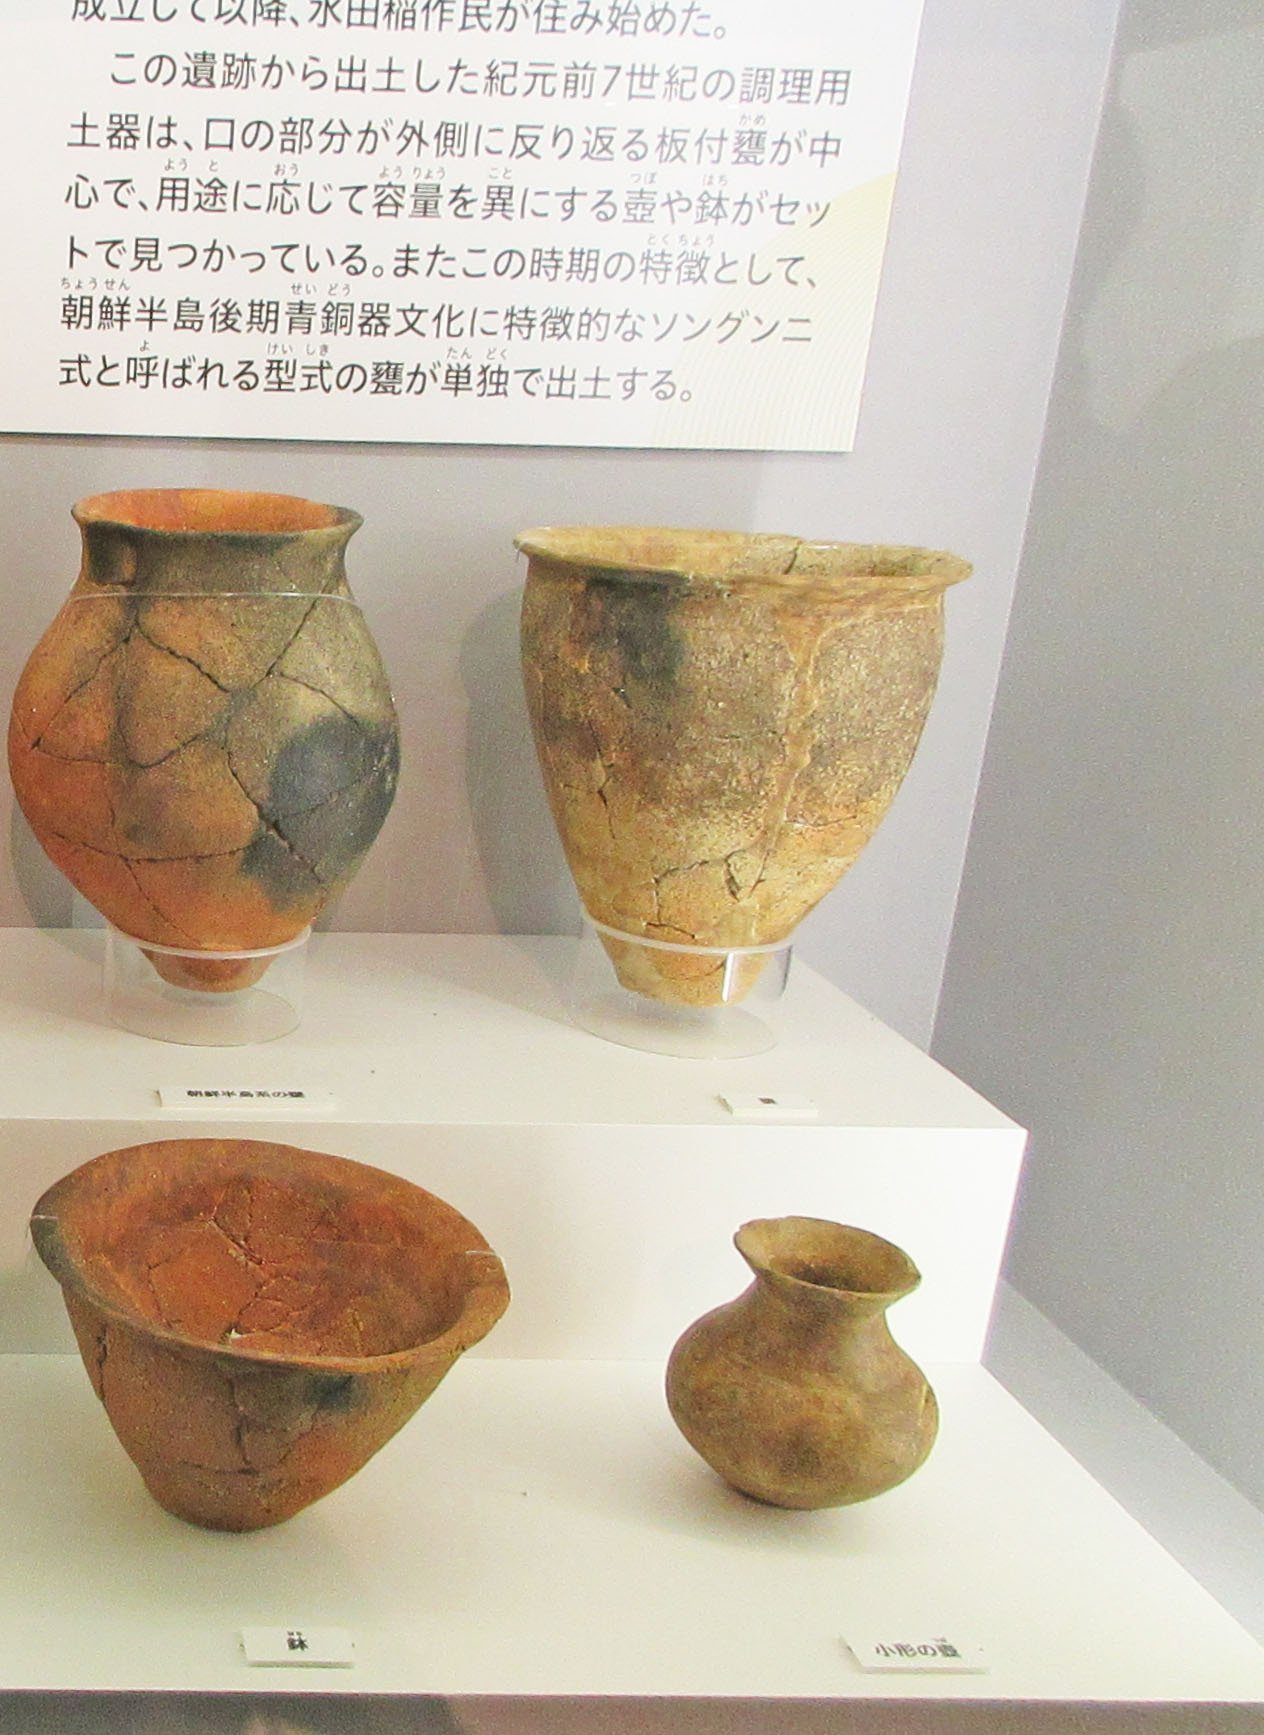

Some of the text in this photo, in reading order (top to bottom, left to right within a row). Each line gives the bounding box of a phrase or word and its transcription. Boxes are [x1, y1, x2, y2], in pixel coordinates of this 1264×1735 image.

[110, 51, 852, 106] この遺跡から出土した紀元前7世紀の調理用
[738, 112, 766, 126] かめ
[67, 112, 842, 168] 土器は、口の部分が外側に反り返る板付甕が中
[164, 157, 189, 172] よう
[209, 160, 219, 172] と
[274, 163, 299, 176] おう
[379, 165, 403, 179] よう
[412, 167, 446, 180] りょう
[489, 168, 512, 180] こと
[702, 172, 728, 186] はち
[647, 233, 715, 248] とく ちょう
[68, 235, 817, 288] トで見つかっている。またこの時期の特徴として、
[60, 276, 352, 296] ちょう せん せい どう
[60, 296, 813, 345] 朝鮮半島後期青銅器文化に特徴的なソングンニ
[140, 340, 508, 361] よ けい しき たん どく
[58, 354, 692, 402] 式と呼ばれる型式の甕が単独で出土する。
